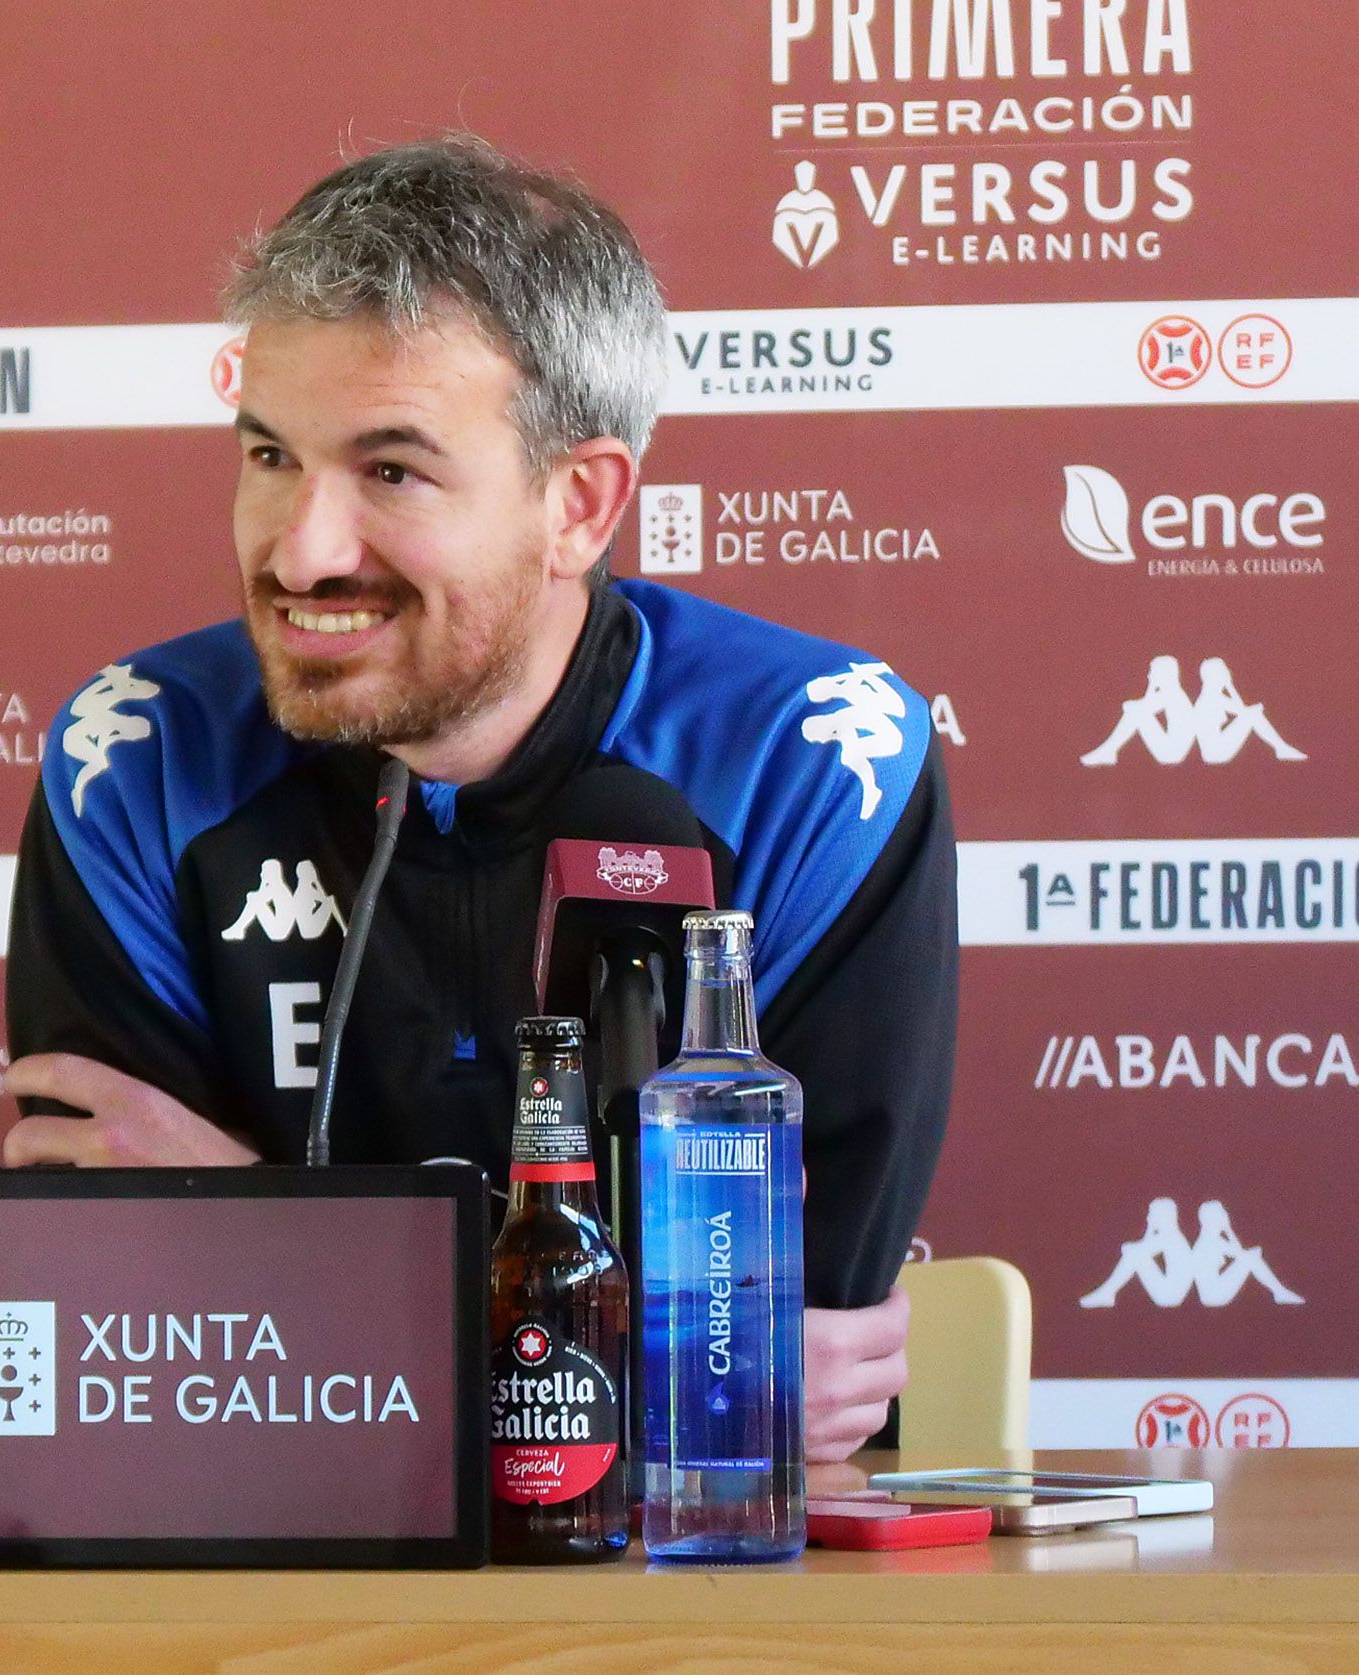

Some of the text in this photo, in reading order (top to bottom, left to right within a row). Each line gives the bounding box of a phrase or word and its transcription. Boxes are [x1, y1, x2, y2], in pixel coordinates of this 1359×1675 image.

[770, 0, 1192, 84] PRIMERA
[771, 84, 1193, 138] FEDERACIÓN
[850, 157, 1195, 227] VERSUS
[891, 231, 1162, 266] E-LEARNING
[673, 326, 894, 371] VERSUS
[700, 374, 874, 396] E-LEARNING
[717, 489, 854, 525] XUNTA
[1141, 492, 1327, 549] ence
[715, 527, 941, 566] DE GALICIA
[1242, 557, 1325, 575] CELULOSA
[1089, 858, 1359, 931] FEDERACI
[268, 981, 321, 1088] E
[519, 1097, 563, 1111] Estrella
[519, 1110, 561, 1125] Galicia
[676, 1138, 766, 1170] REUTILIZABLE
[79, 1313, 288, 1362] XUNTA
[78, 1374, 420, 1424] DE GALICIA
[504, 1450, 565, 1478] Especial
[515, 1448, 550, 1457] CERVEZA
